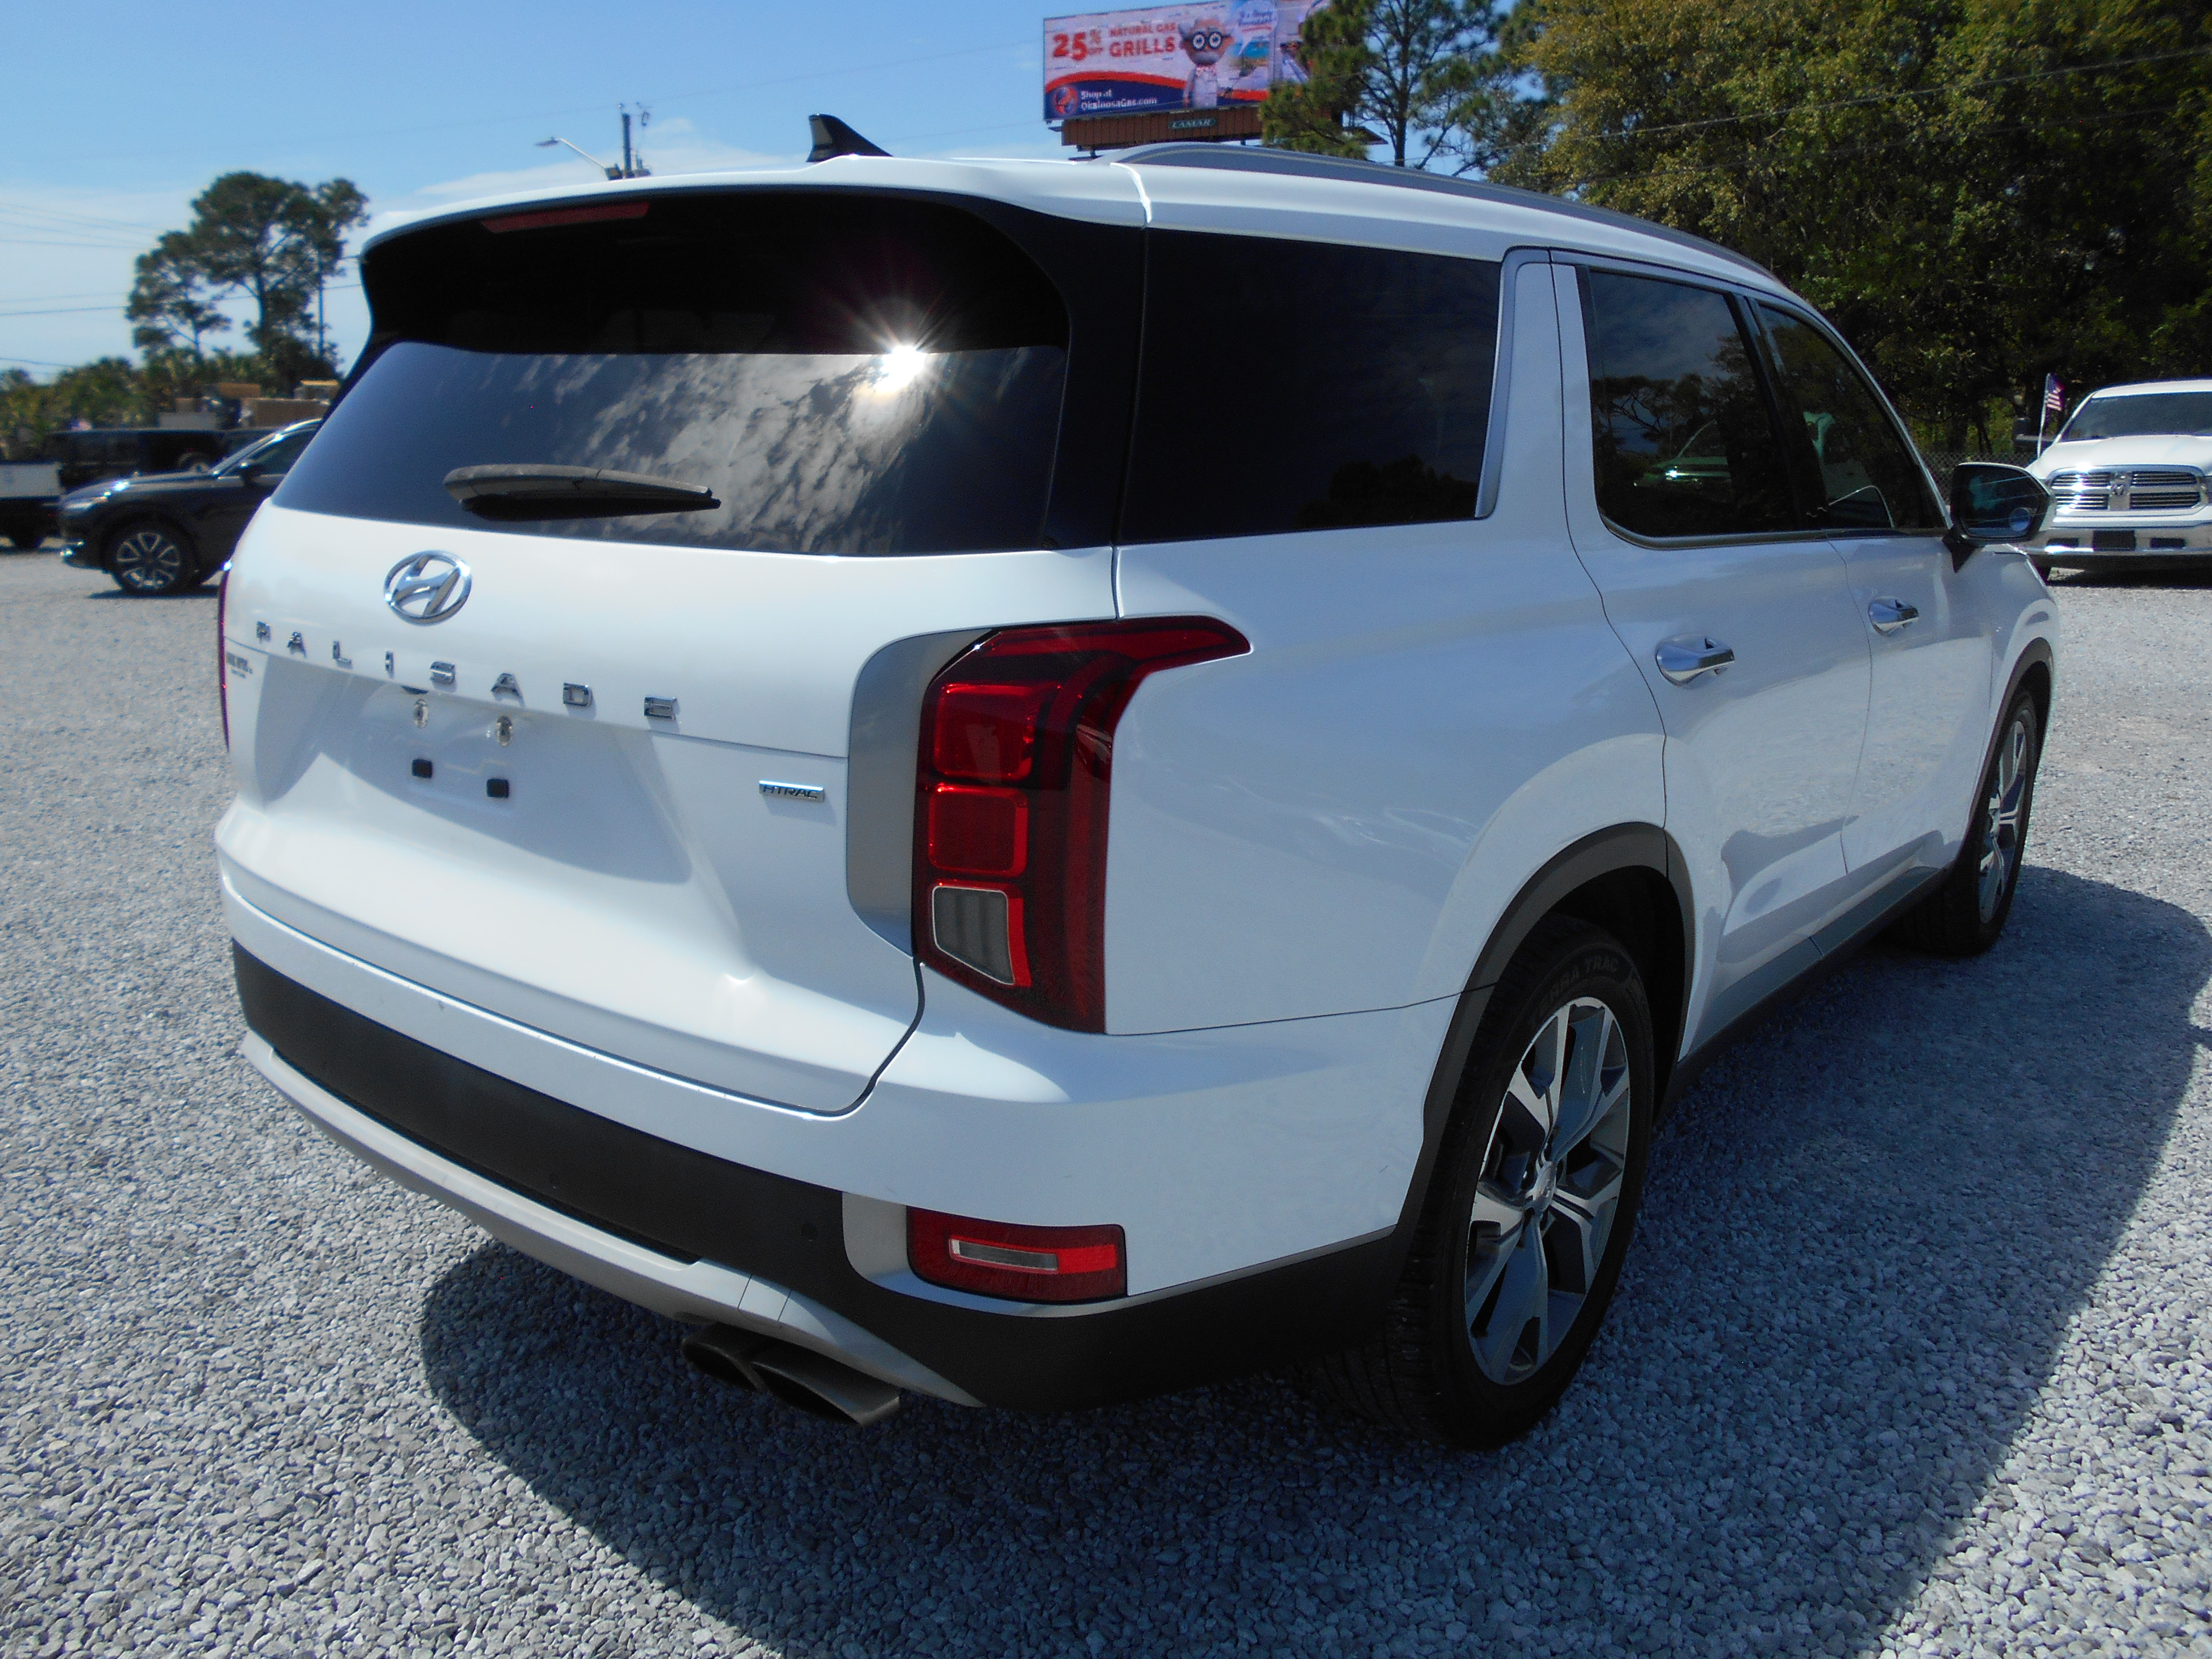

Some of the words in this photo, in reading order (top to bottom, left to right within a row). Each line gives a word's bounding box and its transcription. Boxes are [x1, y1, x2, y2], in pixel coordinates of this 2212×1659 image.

[1109, 24, 1153, 36] NATURAL
[1156, 22, 1177, 32] GAS
[1109, 36, 1175, 57] GRILLS
[1081, 90, 1101, 100] Shop
[1172, 119, 1210, 128] LAMAR
[256, 620, 678, 721] PALISADE
[763, 784, 817, 799] HTRAC
